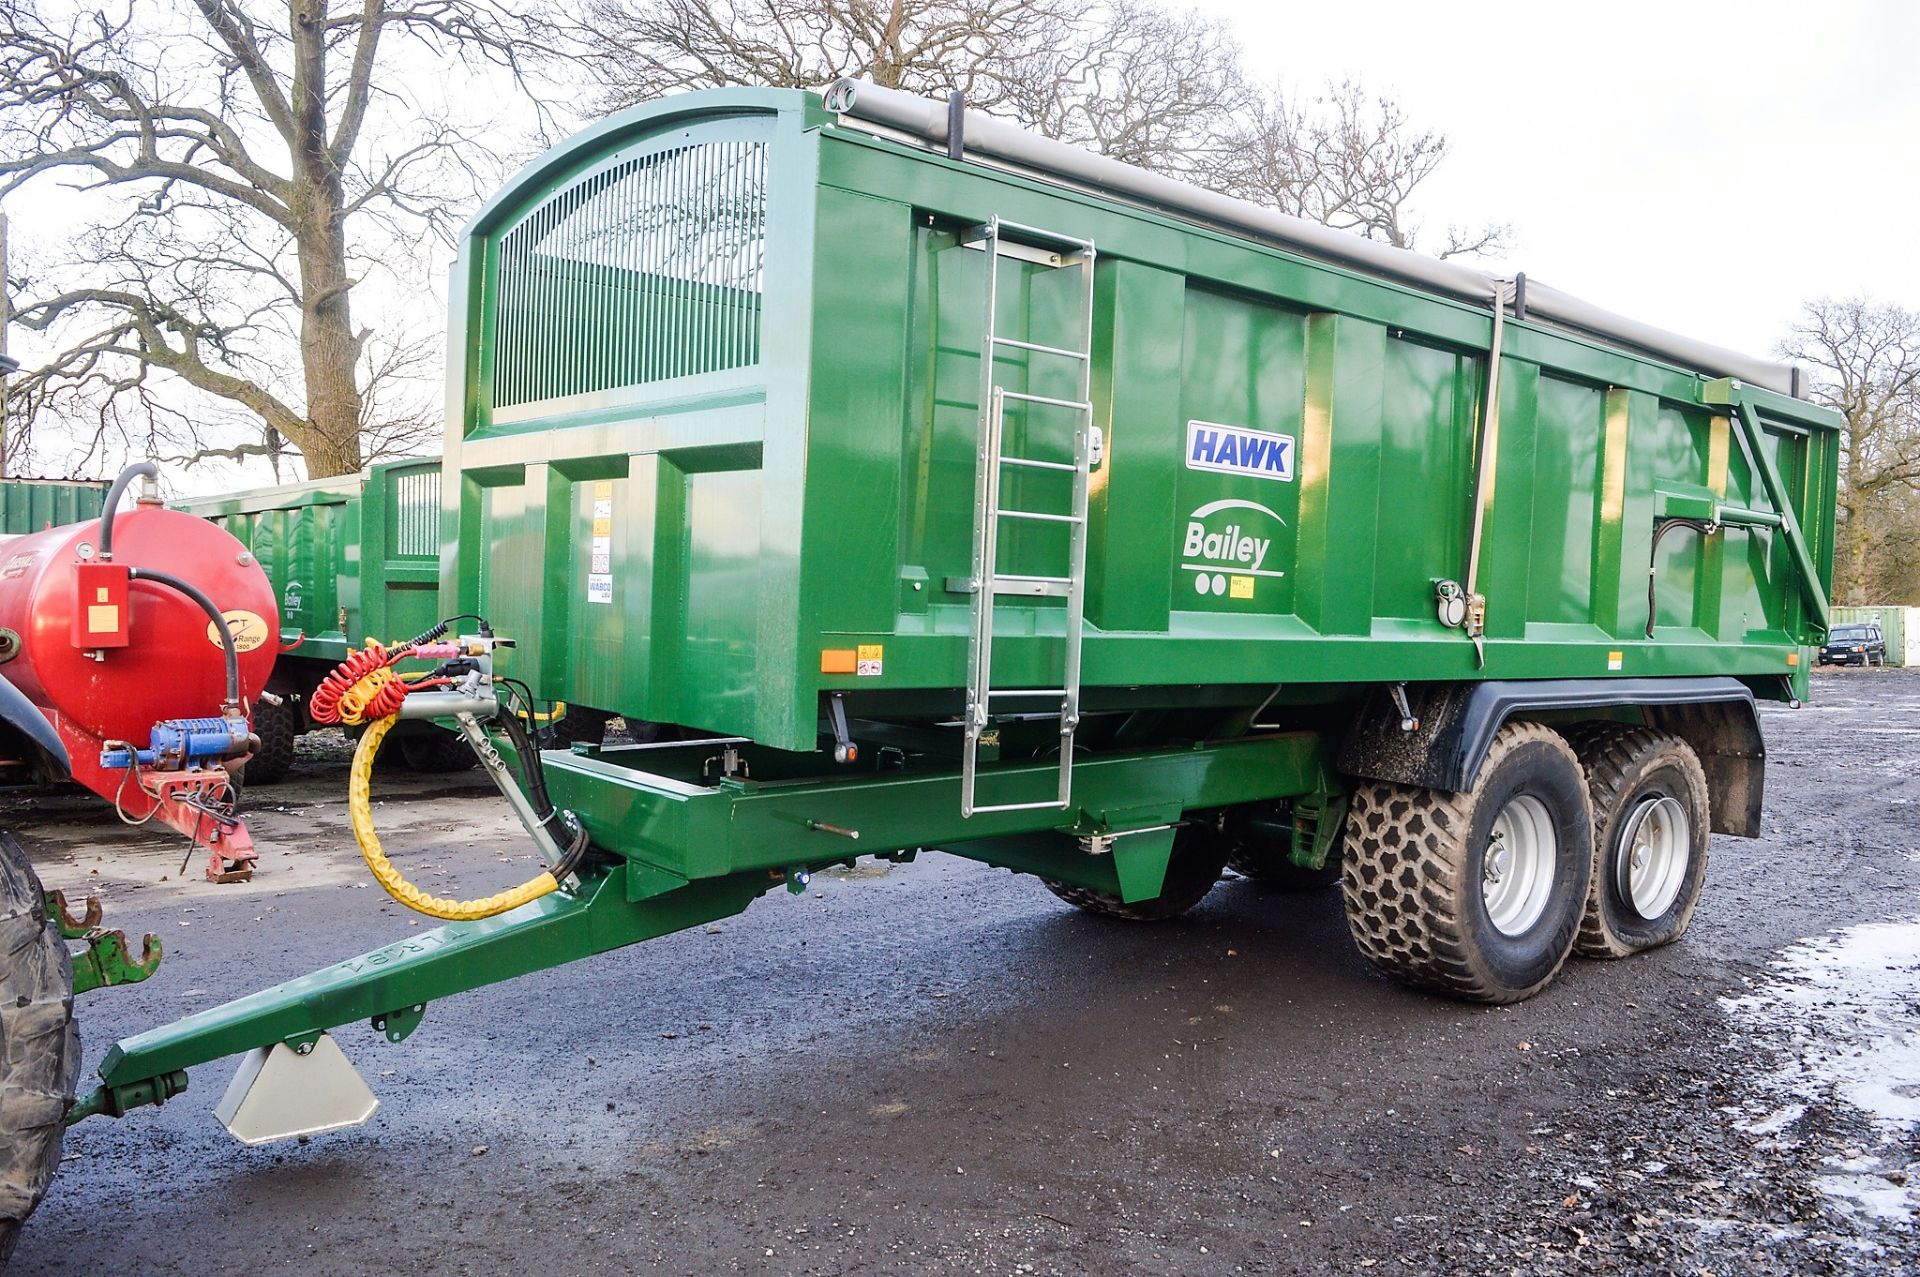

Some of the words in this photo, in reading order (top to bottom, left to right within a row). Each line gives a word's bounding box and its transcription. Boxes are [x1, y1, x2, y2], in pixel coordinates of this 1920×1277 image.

[1192, 429, 1289, 473] HAWK
[1183, 521, 1271, 570] Bailey
[284, 592, 302, 609] Bailey
[238, 635, 261, 643] Range
